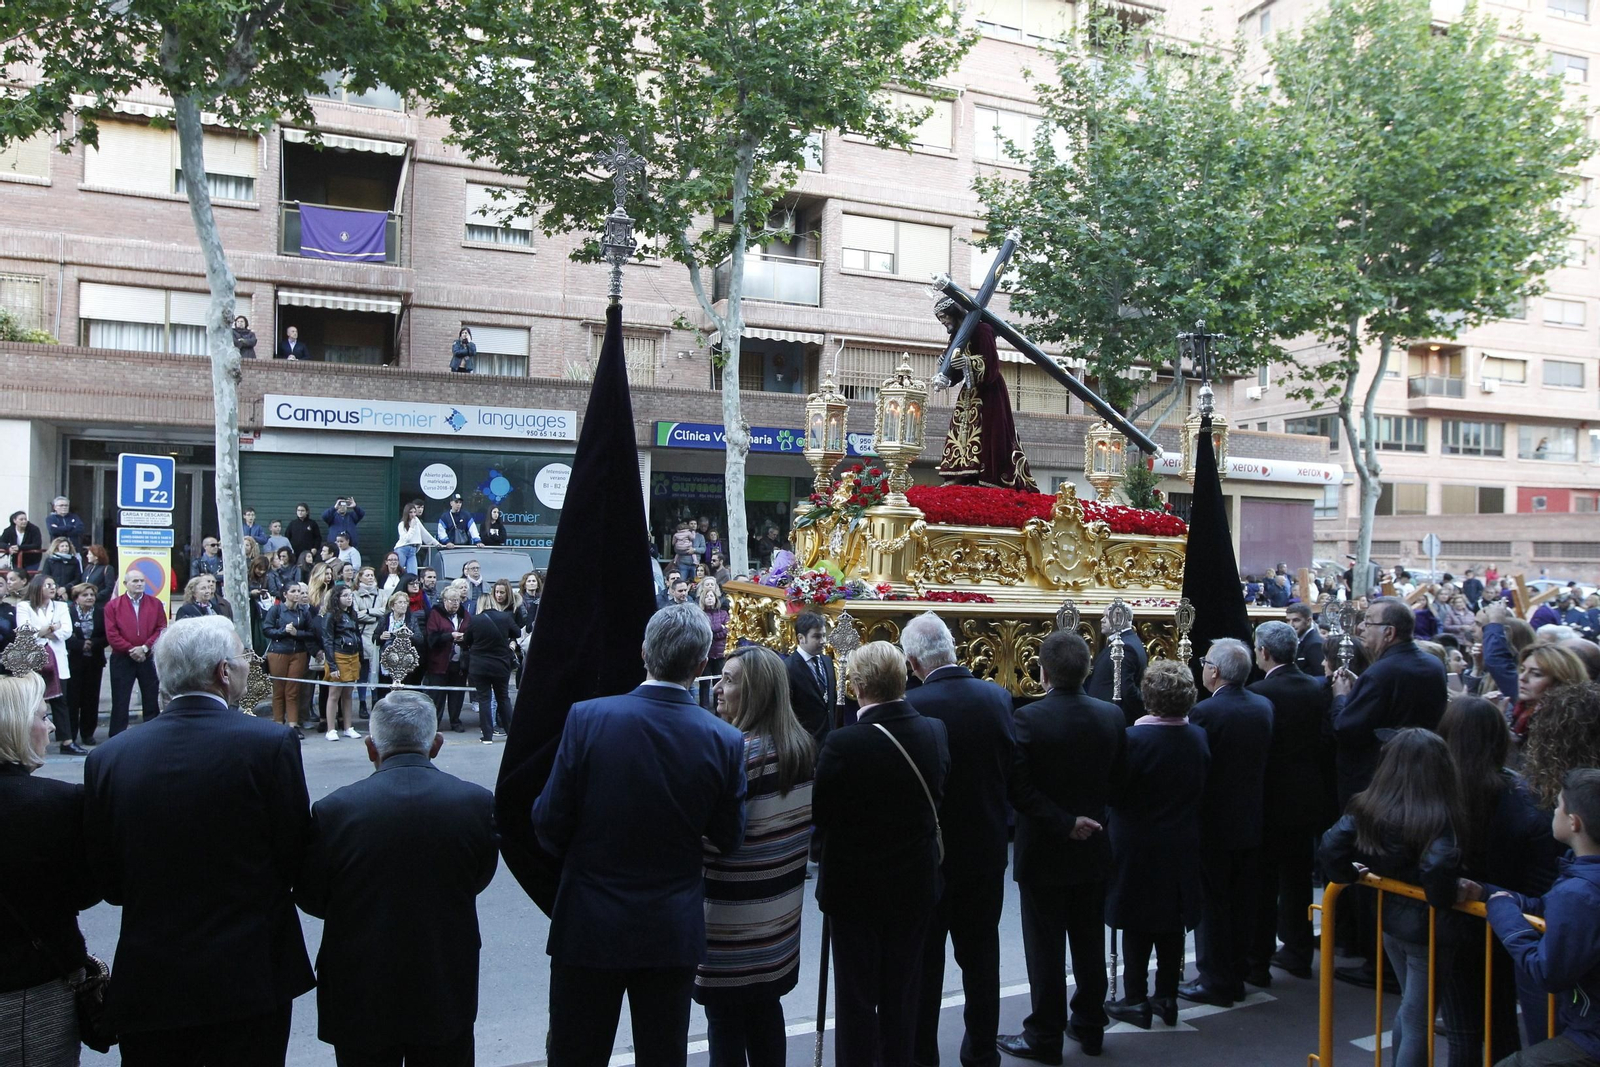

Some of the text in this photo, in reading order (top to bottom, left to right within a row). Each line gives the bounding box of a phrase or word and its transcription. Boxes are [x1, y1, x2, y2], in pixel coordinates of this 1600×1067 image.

[478, 408, 566, 432] languages
[526, 429, 538, 437] 950
[550, 430, 557, 438] 14
[674, 429, 711, 441] Clínica
[1232, 463, 1259, 473] xerox
[1297, 467, 1322, 477] xerox
[134, 463, 162, 503] P
[149, 490, 168, 504] Z2
